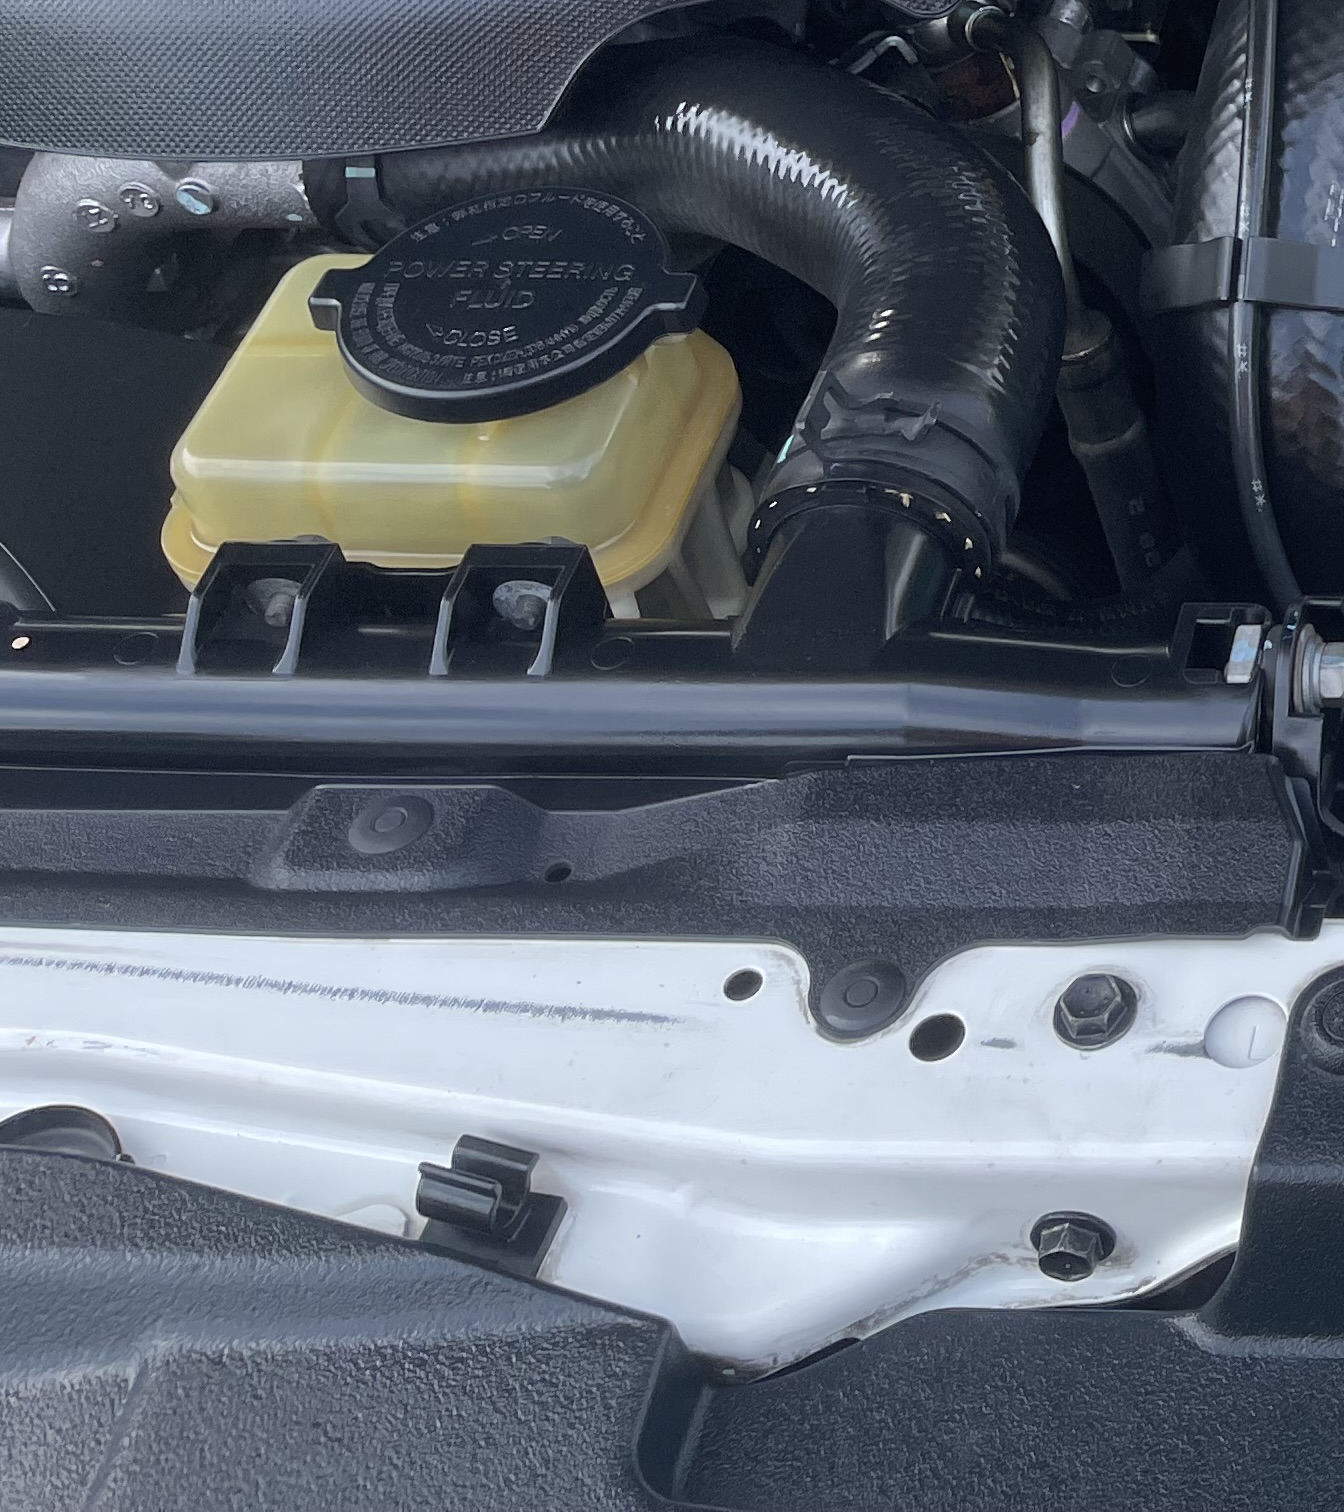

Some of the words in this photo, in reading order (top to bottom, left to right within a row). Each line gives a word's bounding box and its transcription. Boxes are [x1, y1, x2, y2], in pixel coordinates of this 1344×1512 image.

[501, 224, 564, 242] OPEN
[385, 260, 490, 280] POWER
[493, 260, 637, 282] STEERING
[448, 288, 537, 310] FLUID
[443, 324, 519, 348] CLOSE
